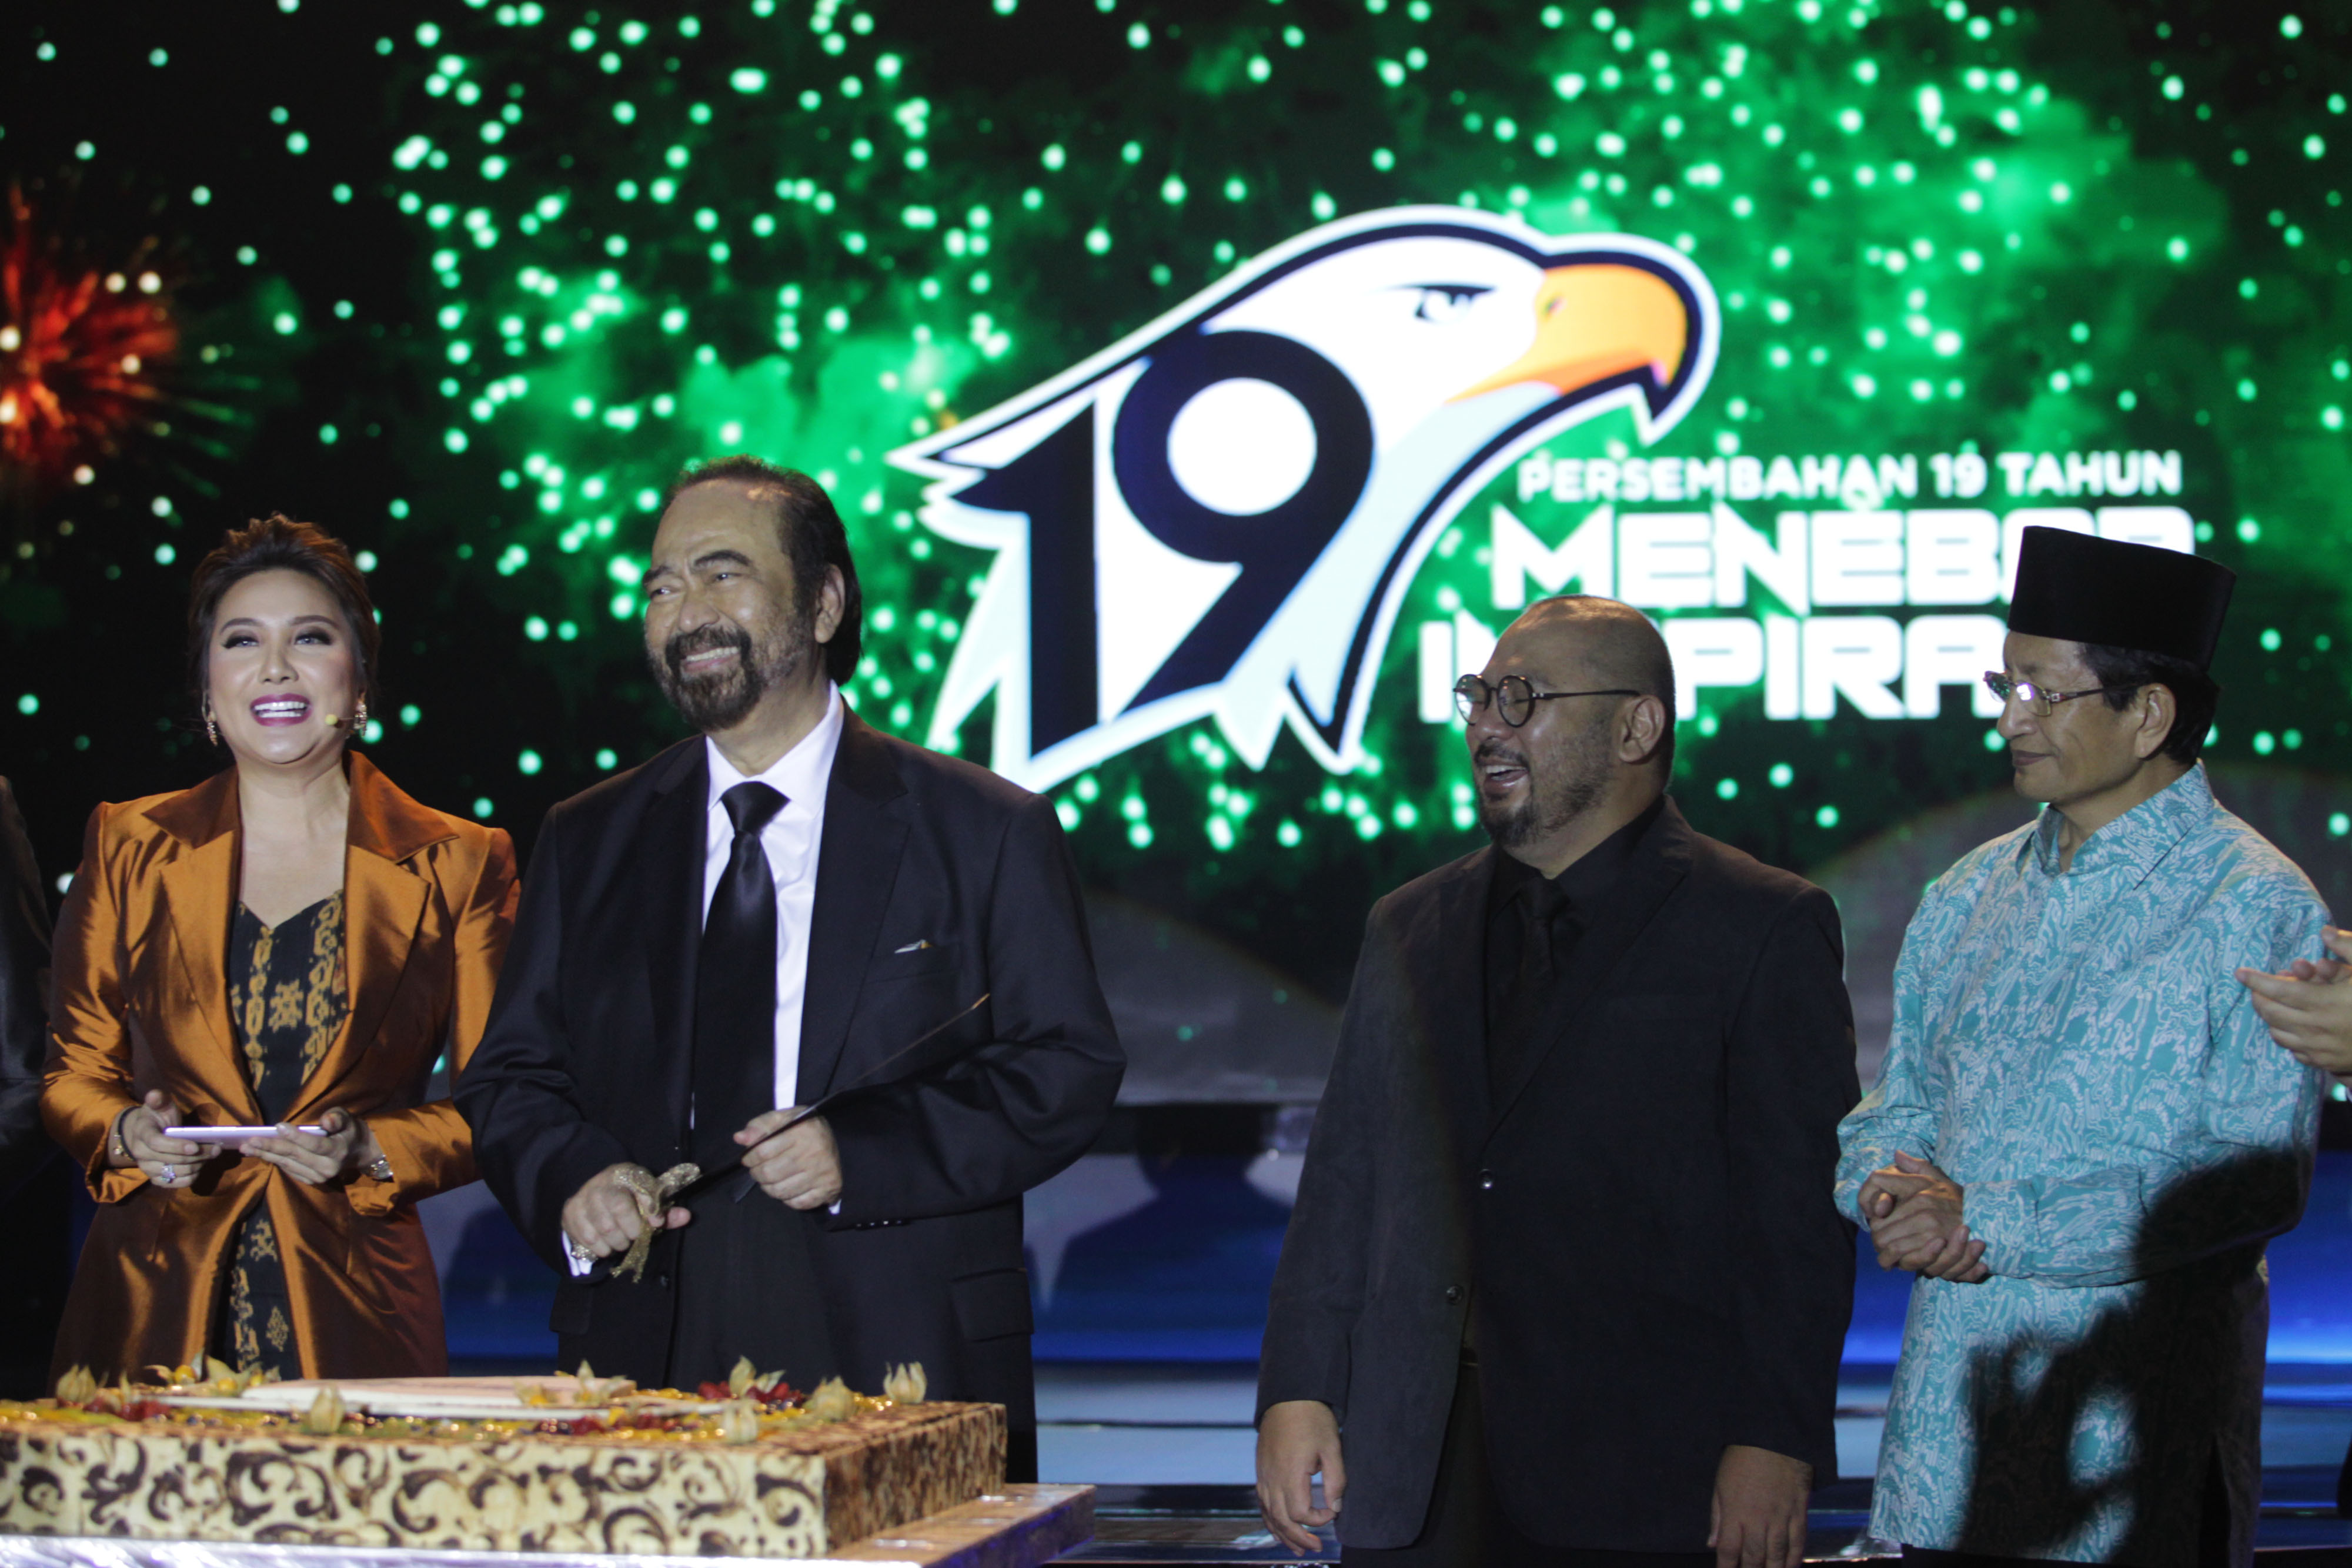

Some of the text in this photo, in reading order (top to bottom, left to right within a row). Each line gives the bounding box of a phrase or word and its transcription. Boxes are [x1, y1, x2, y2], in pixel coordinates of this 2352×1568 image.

[1517, 450, 2183, 503] PERSEMBAHAN 19 TAHUN
[951, 329, 1375, 762] 19
[1490, 500, 2196, 616] MENEB
[1419, 609, 2011, 723] IPIRA
